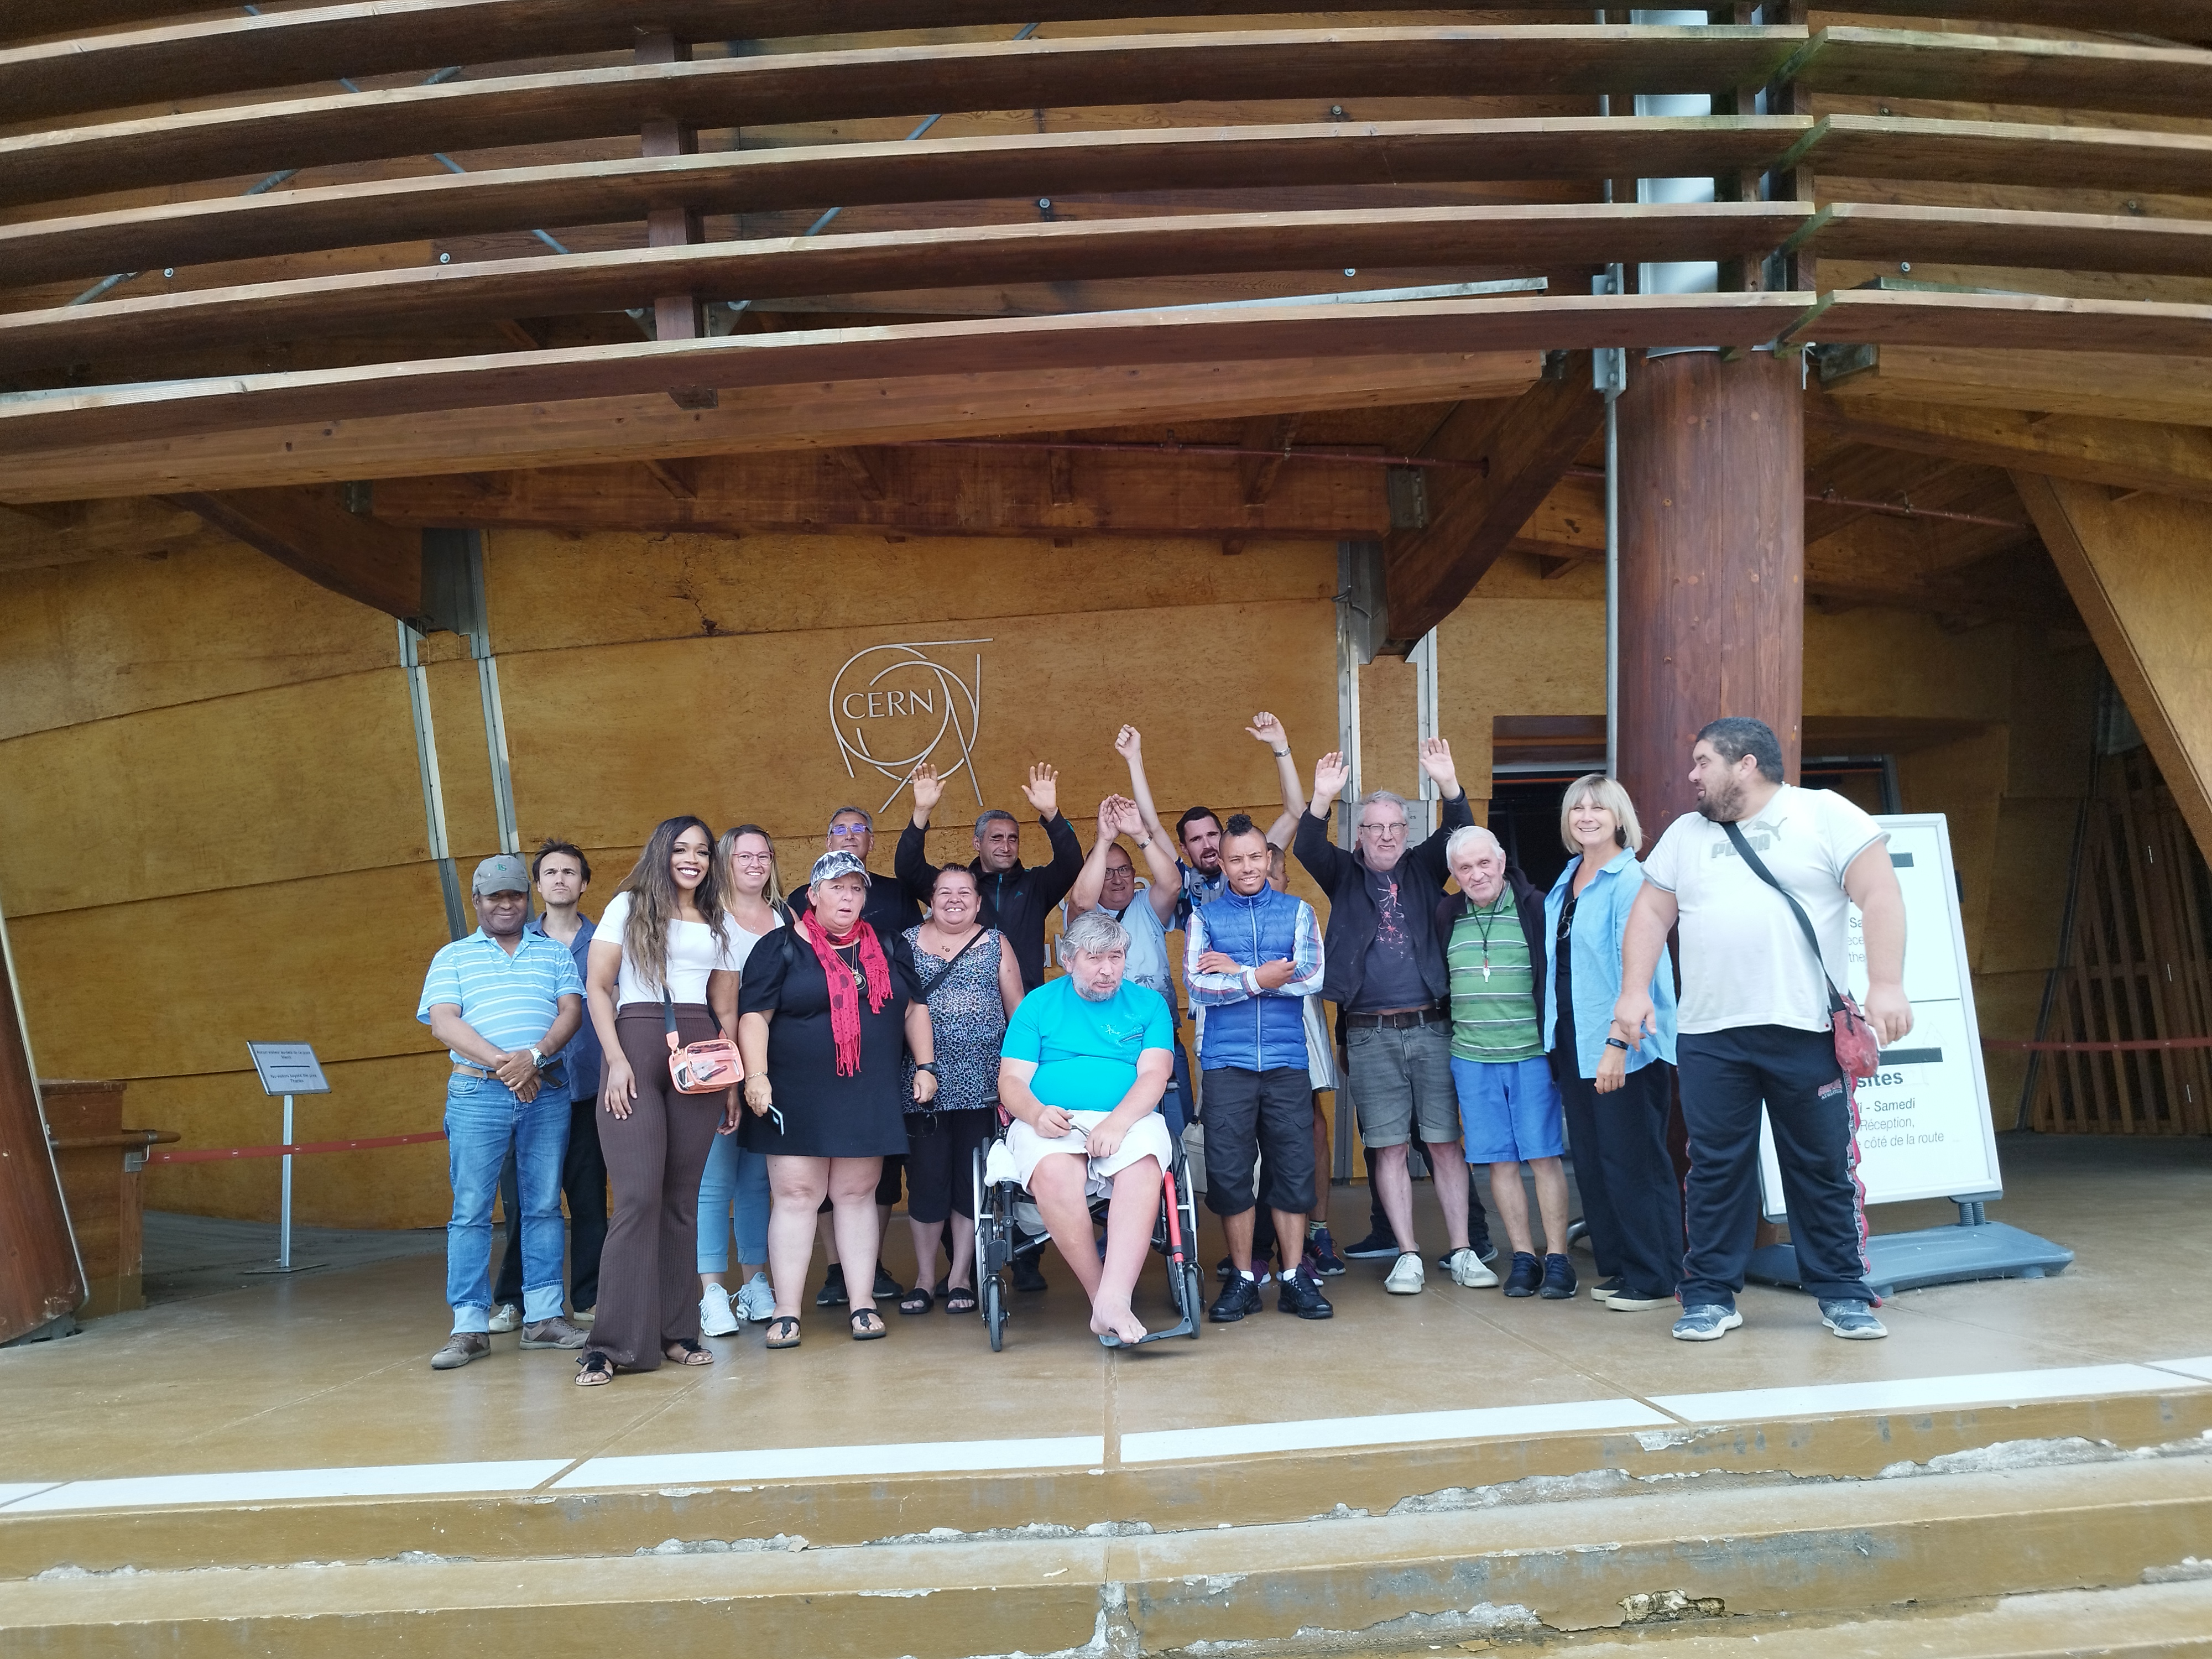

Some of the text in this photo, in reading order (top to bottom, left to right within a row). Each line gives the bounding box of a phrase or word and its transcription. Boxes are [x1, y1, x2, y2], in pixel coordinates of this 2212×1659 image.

[842, 688, 935, 719] CERN
[1874, 1098, 1916, 1112] Samedi
[1860, 1117, 1914, 1131] Réception,
[1864, 1136, 1887, 1149] côté
[1890, 1135, 1903, 1146] de
[1907, 1134, 1914, 1145] la
[1918, 1131, 1944, 1143] route
